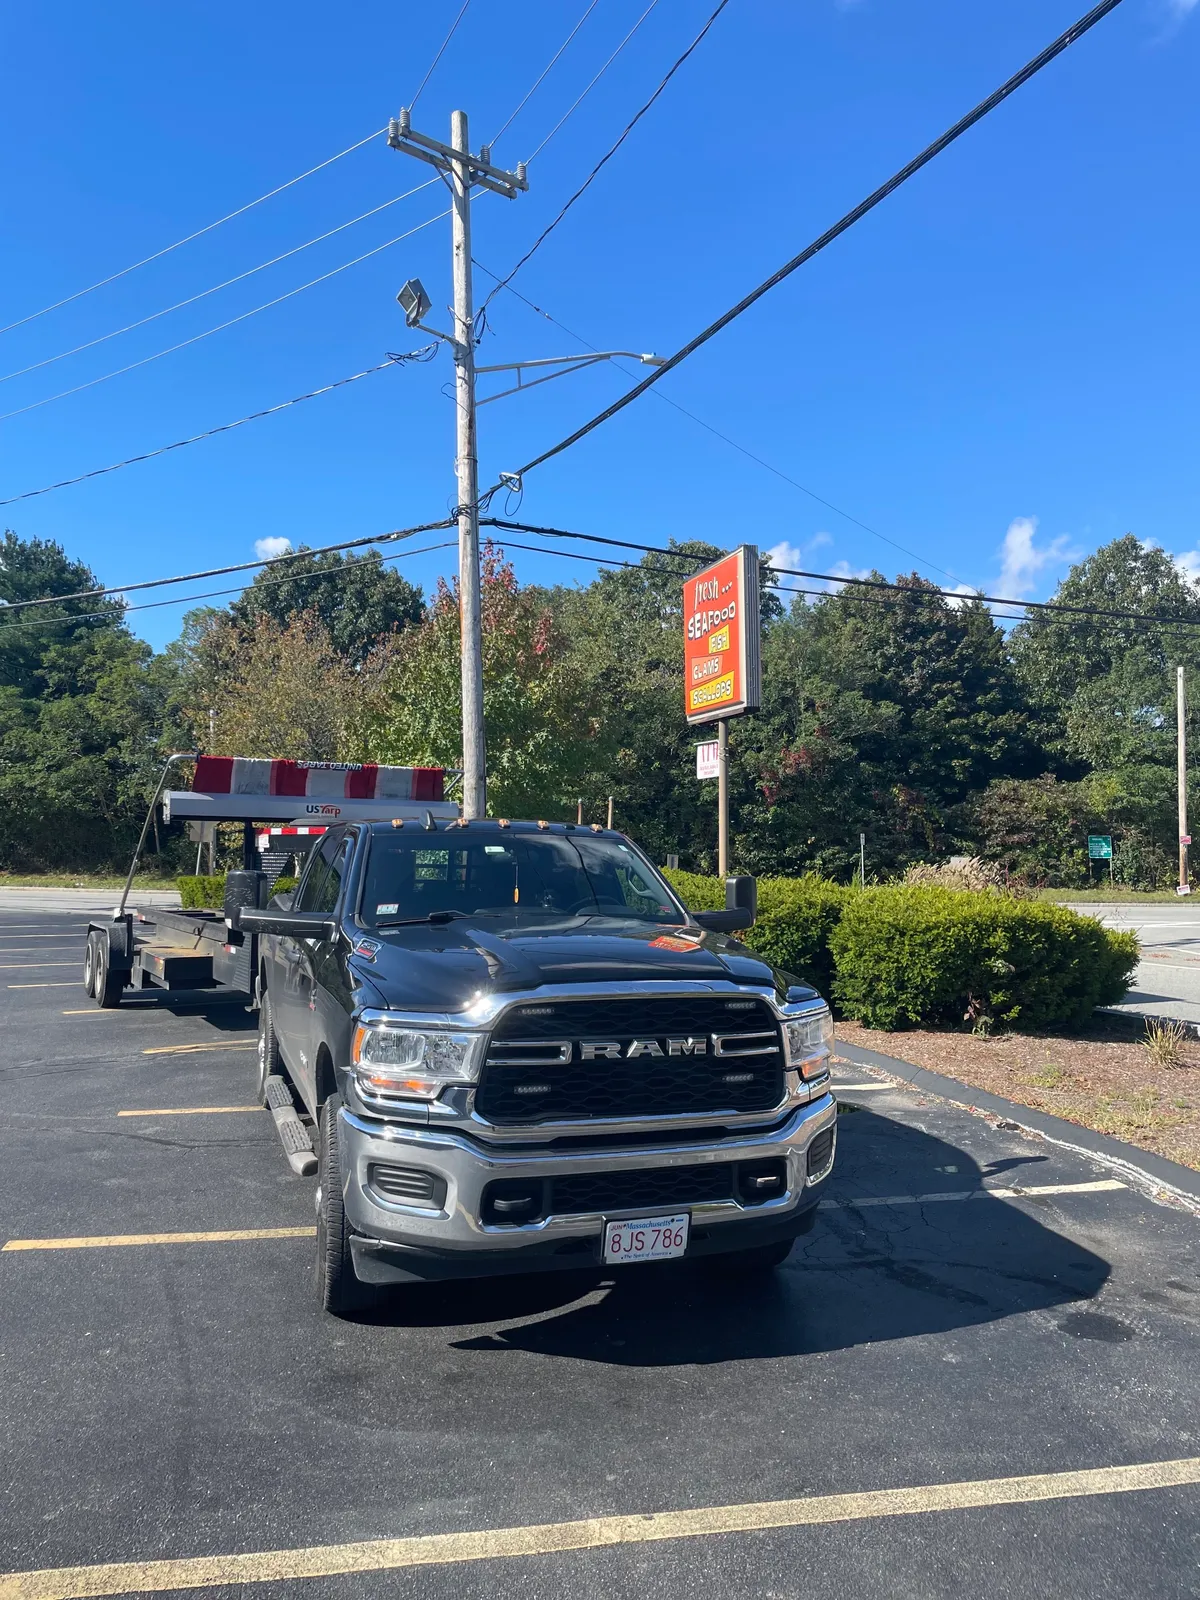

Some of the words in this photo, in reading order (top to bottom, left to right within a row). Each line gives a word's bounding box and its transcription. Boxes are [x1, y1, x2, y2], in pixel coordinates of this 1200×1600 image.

[694, 576, 719, 610] fresh
[688, 601, 736, 639] SEAFOOD
[711, 631, 727, 651] FISH
[693, 657, 719, 680] CLAMS
[693, 679, 731, 705] SCALLOPS
[297, 760, 327, 769] TARPS
[330, 762, 362, 771] UNITED
[579, 1037, 707, 1060] RAM
[611, 1223, 623, 1231] JUN
[625, 1219, 671, 1230] Massachusetts
[611, 1230, 646, 1253] 8JS
[651, 1226, 684, 1250] 786
